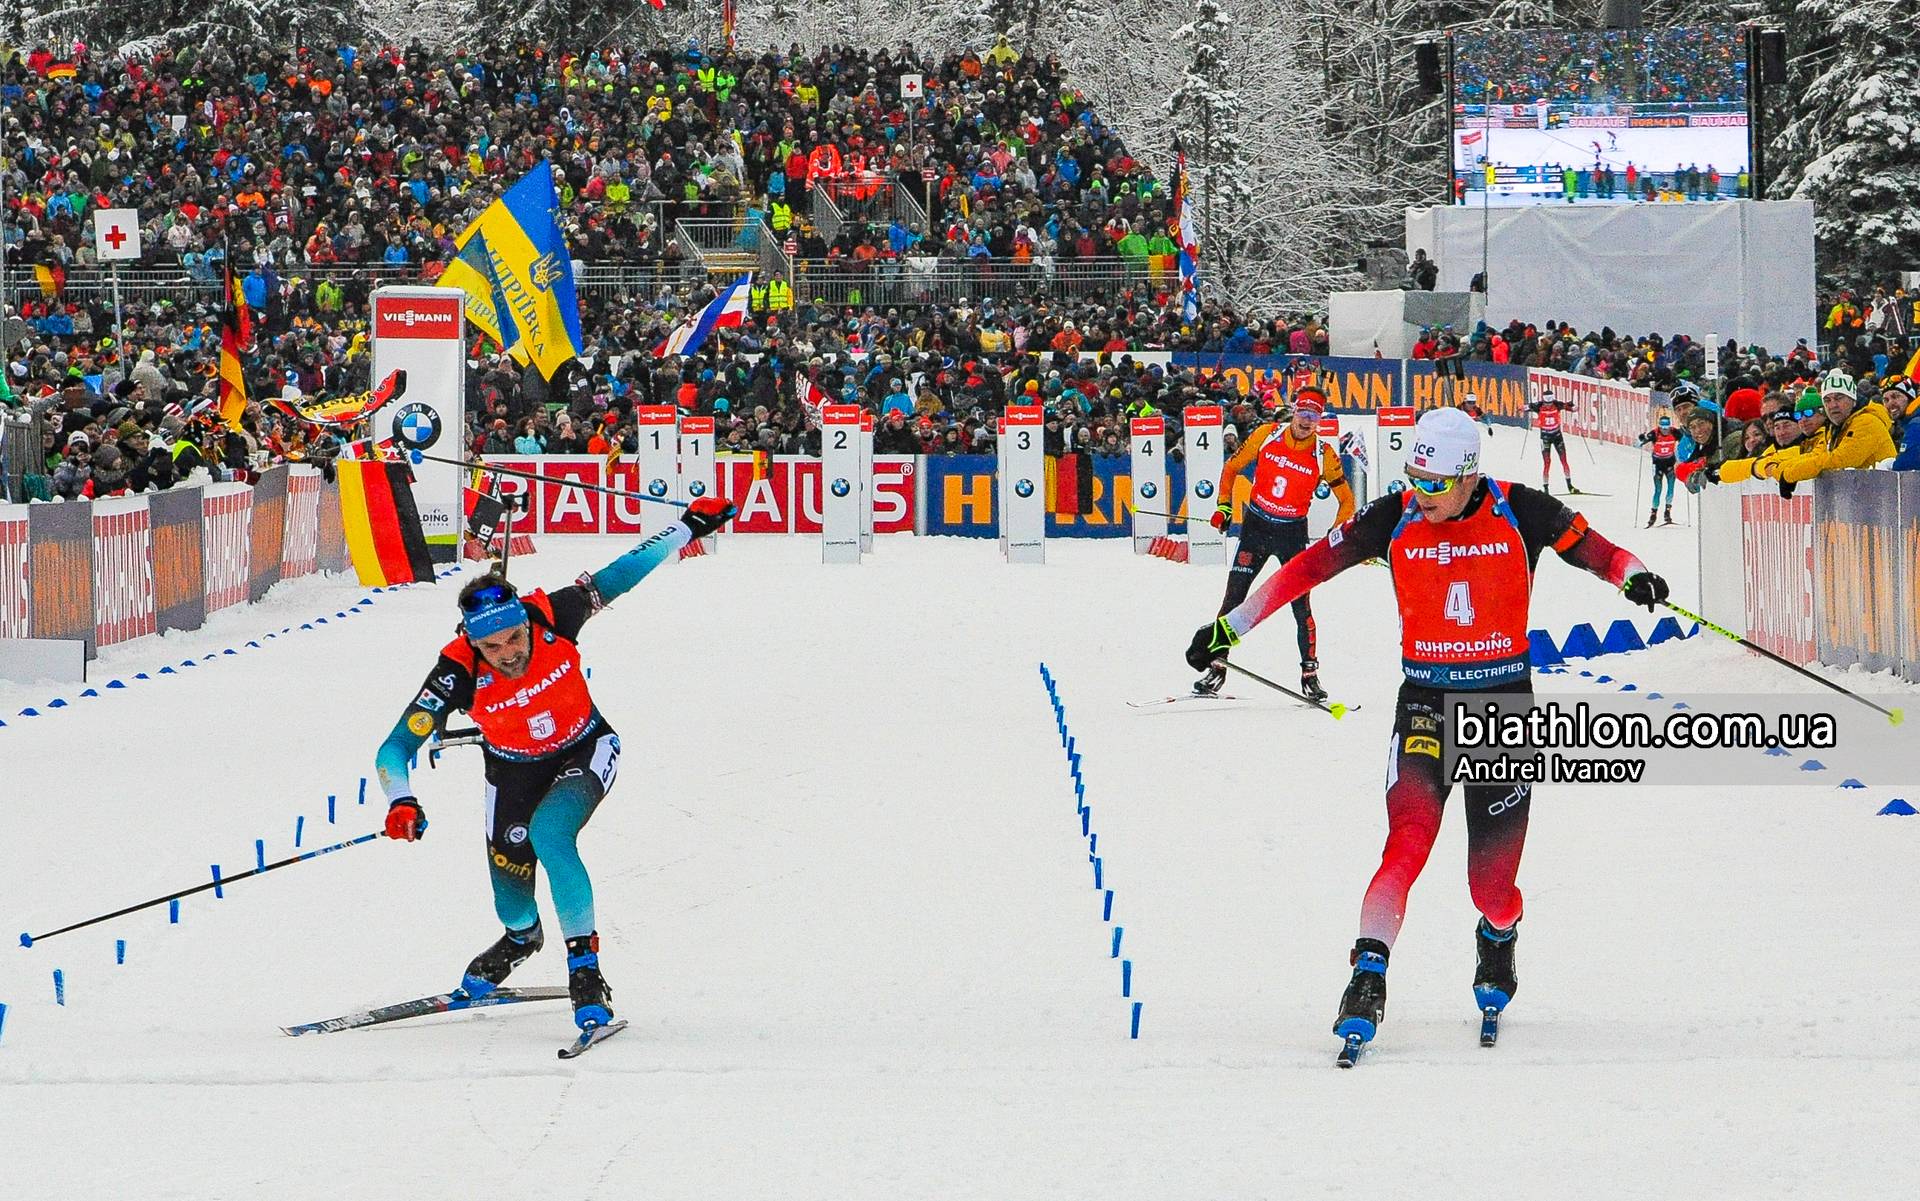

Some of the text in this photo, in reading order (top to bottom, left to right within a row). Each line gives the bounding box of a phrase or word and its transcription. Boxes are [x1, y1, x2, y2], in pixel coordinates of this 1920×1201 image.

[384, 310, 452, 326] VIESSMANN
[650, 431, 660, 449] 1
[690, 439, 699, 456] 1
[834, 431, 847, 449] 2
[1017, 431, 1031, 450] 3
[1141, 440, 1153, 456] 4
[1196, 431, 1210, 450] 4
[1389, 432, 1403, 450] 5
[1413, 438, 1436, 458] ice
[1265, 451, 1313, 476] VIESSMANN
[1271, 475, 1288, 499] 3
[1405, 541, 1509, 565] VIESSMANN
[1444, 581, 1475, 626] 4
[1415, 636, 1512, 653] RUHPOLDING
[1405, 666, 1431, 679] BMW
[1449, 661, 1524, 681] ELECTRIFIED
[485, 660, 571, 713] VIESSMANN
[526, 709, 557, 740] 5
